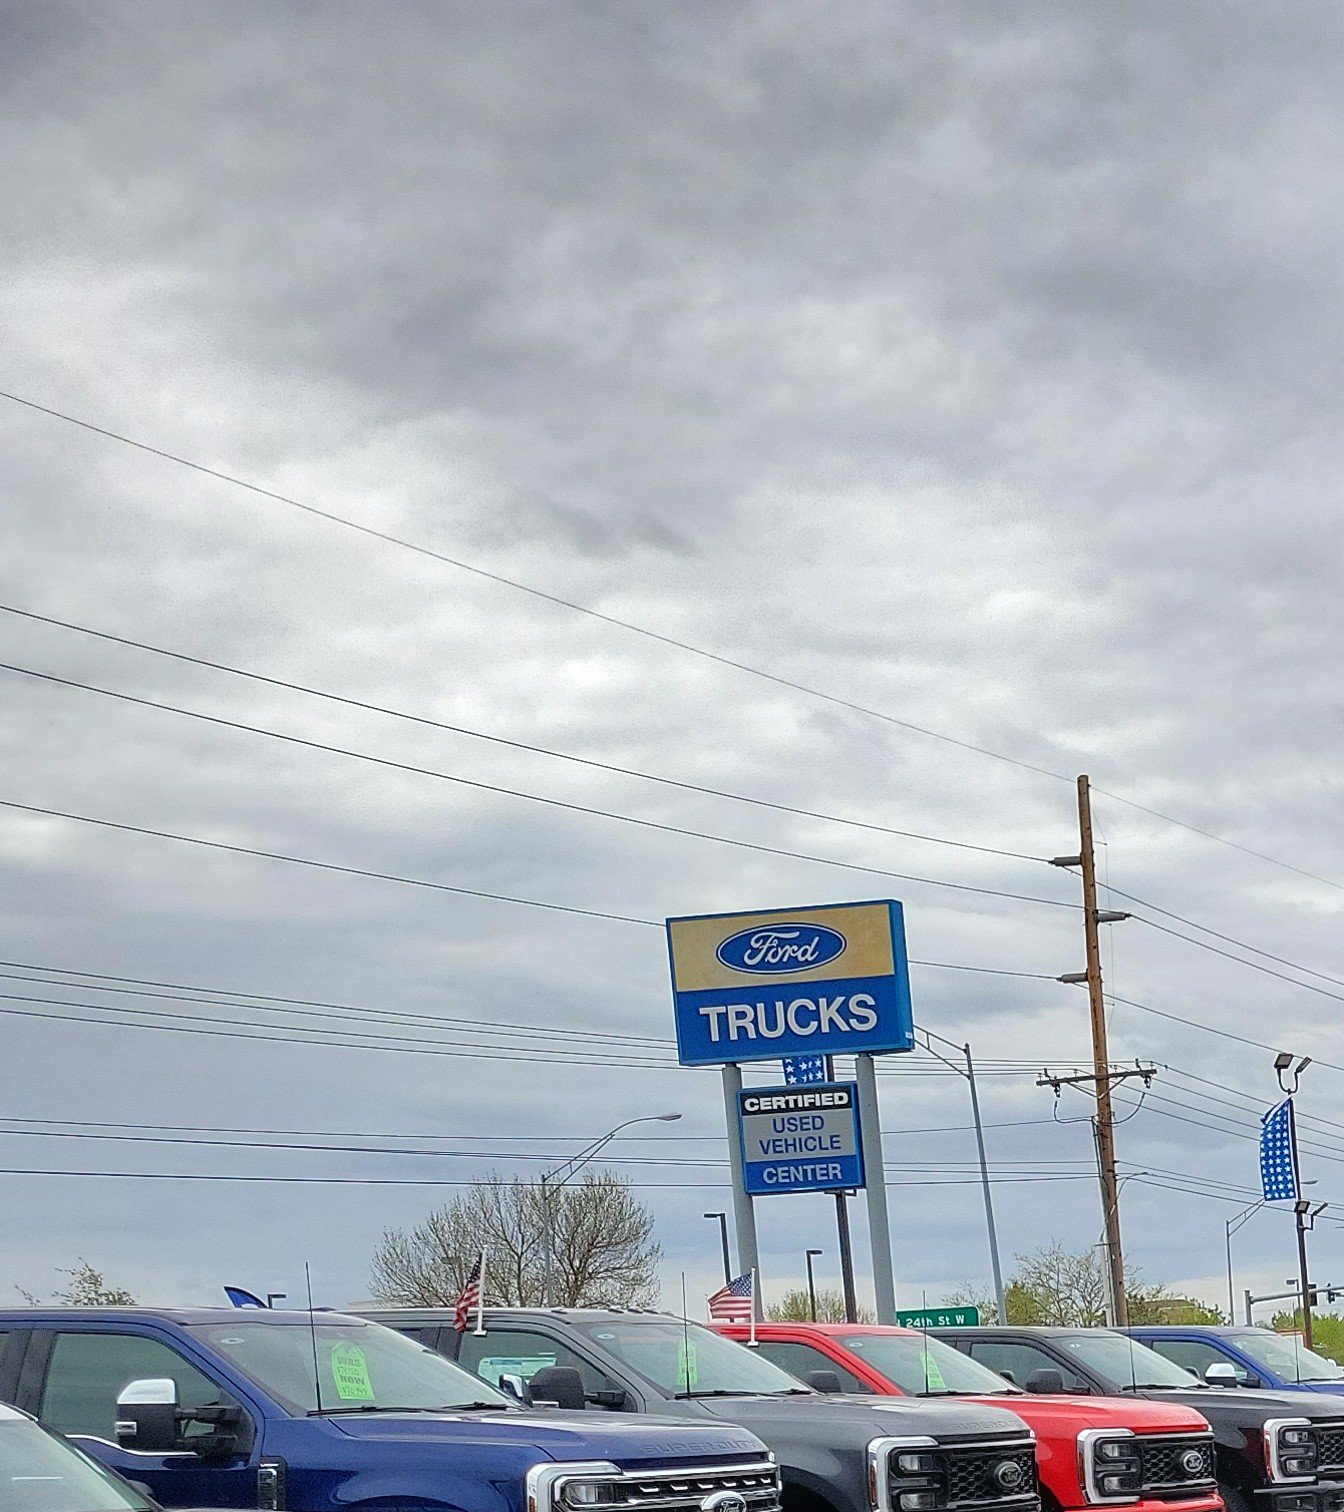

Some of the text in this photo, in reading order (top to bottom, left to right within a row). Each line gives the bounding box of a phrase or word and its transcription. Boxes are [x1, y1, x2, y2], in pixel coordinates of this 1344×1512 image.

[744, 931, 819, 965] Ford
[699, 993, 878, 1042] TRUCKS
[744, 1092, 849, 1112] CERTIFIED
[772, 1115, 825, 1133] USED
[759, 1135, 842, 1156] VEHICLE
[762, 1163, 843, 1184] CENTER
[906, 1317, 933, 1328] 24th
[938, 1315, 951, 1326] St
[955, 1314, 965, 1325] W
[642, 1442, 714, 1455] SUPER
